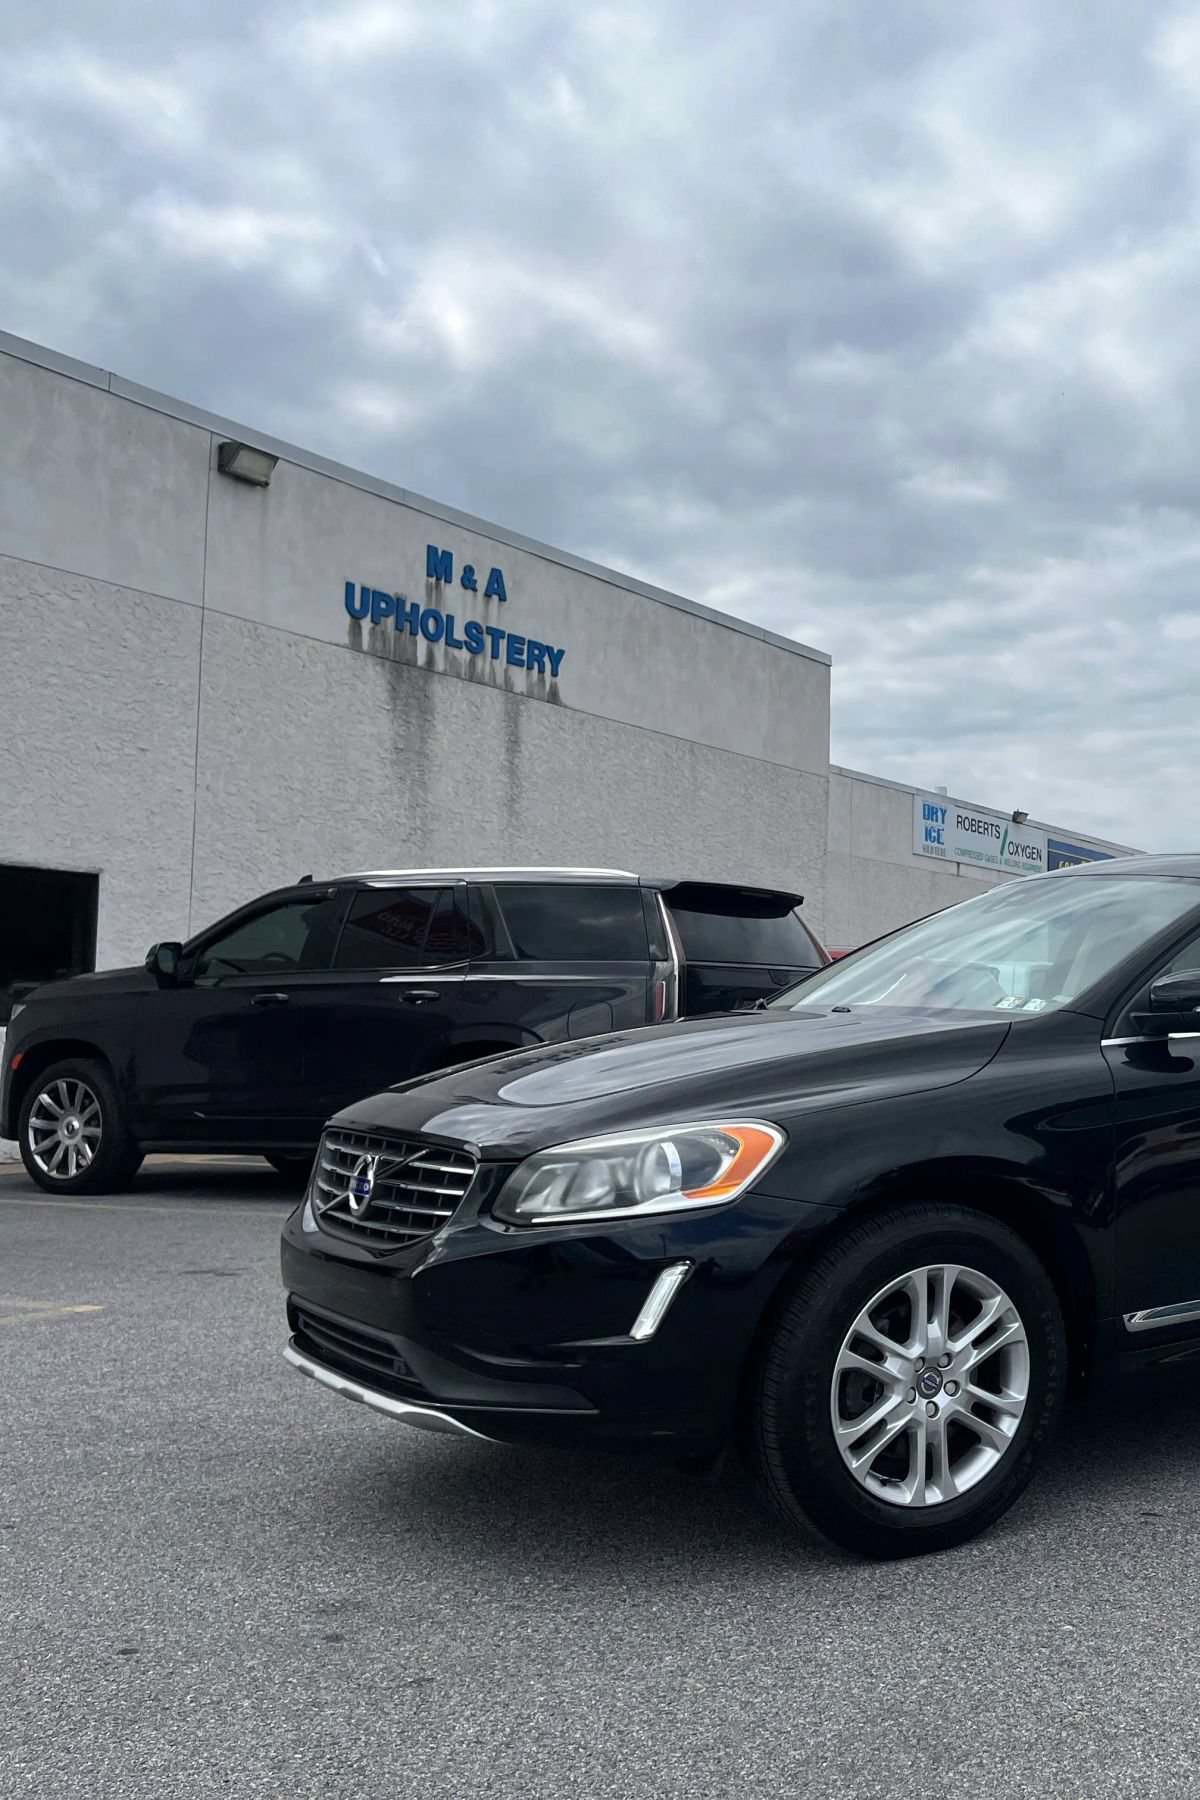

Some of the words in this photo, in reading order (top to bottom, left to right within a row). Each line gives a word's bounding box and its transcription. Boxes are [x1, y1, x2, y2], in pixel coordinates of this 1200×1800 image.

[426, 544, 453, 584] M
[460, 564, 478, 592] &
[484, 567, 507, 602] A
[344, 581, 566, 677] UPHOLSTERY
[922, 803, 948, 825] DRY
[924, 825, 945, 845] ICE
[956, 815, 1001, 840] ROBERTS
[1007, 840, 1042, 862] OXYGEN
